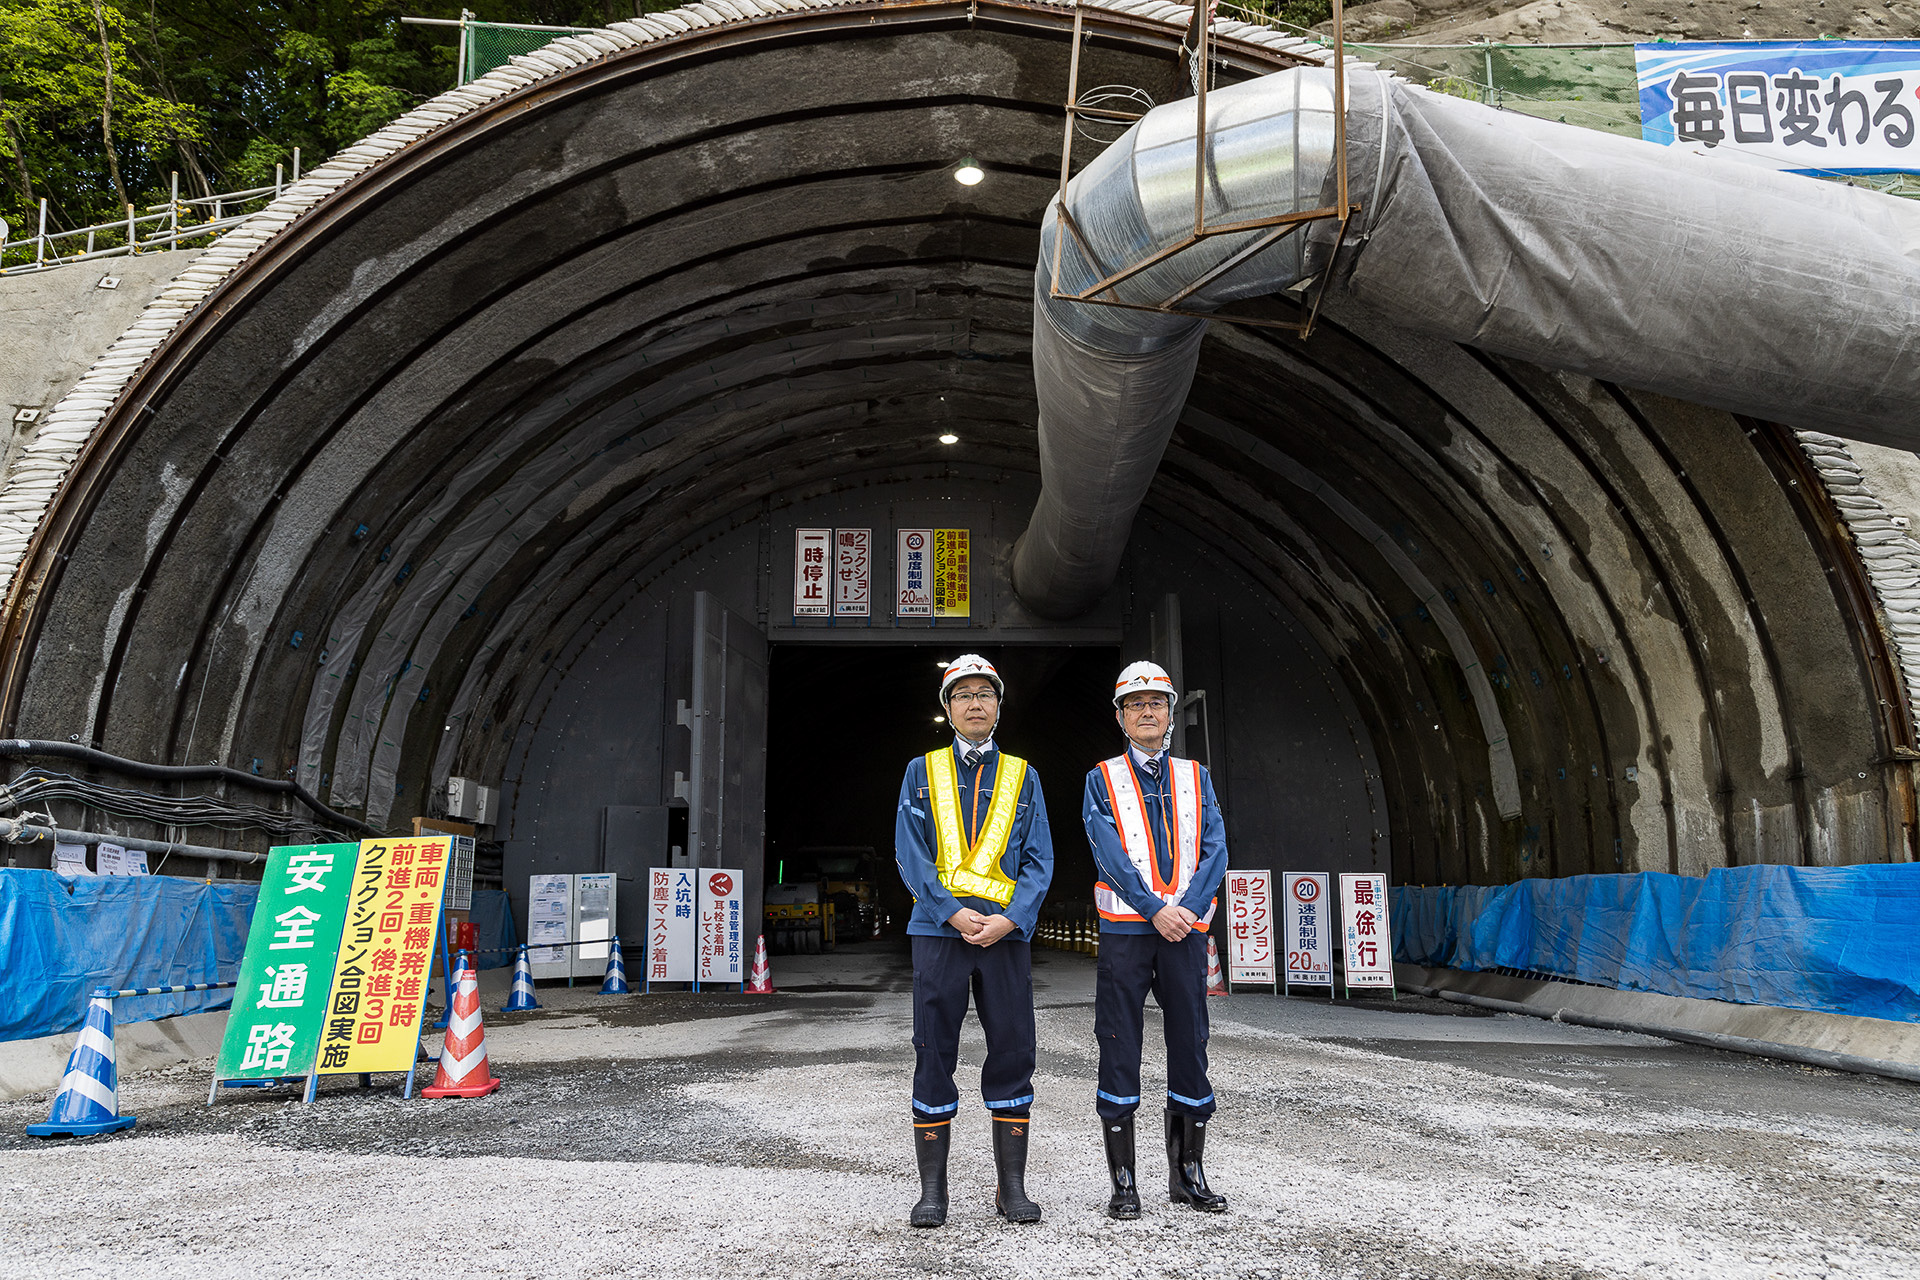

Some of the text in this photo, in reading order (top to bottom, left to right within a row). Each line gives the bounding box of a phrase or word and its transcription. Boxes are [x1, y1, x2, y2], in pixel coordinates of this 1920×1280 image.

[1671, 72, 1914, 148] 毎日変わる
[803, 536, 824, 599] 一時停止
[839, 533, 854, 599] 鳴らせ!
[854, 532, 867, 600] クラクション
[907, 551, 922, 589] 速度制限
[910, 537, 921, 546] 20
[935, 530, 946, 616] クラクション合図実施
[946, 531, 957, 607] 前進2回・後進3回
[957, 531, 968, 602] 車両・重機発進時
[675, 872, 692, 919] 入坑時
[1231, 877, 1250, 962] 鳴らせ!
[1250, 876, 1269, 962] クラクション
[1299, 883, 1314, 897] 20
[1354, 880, 1378, 967] 最徐行
[1374, 879, 1383, 922] 工事中につき
[320, 844, 387, 1069] クラクション合図実施
[357, 843, 417, 1044] 前進2回・後進3回
[389, 842, 445, 1028] 車両・重機発進時
[651, 871, 669, 979] 防塵マスク着用
[701, 911, 713, 979] してください
[713, 900, 725, 957] 耳栓を着用
[1298, 903, 1318, 951] 速度制限
[1348, 926, 1357, 968] お願いします
[240, 851, 335, 1071] 安全通路
